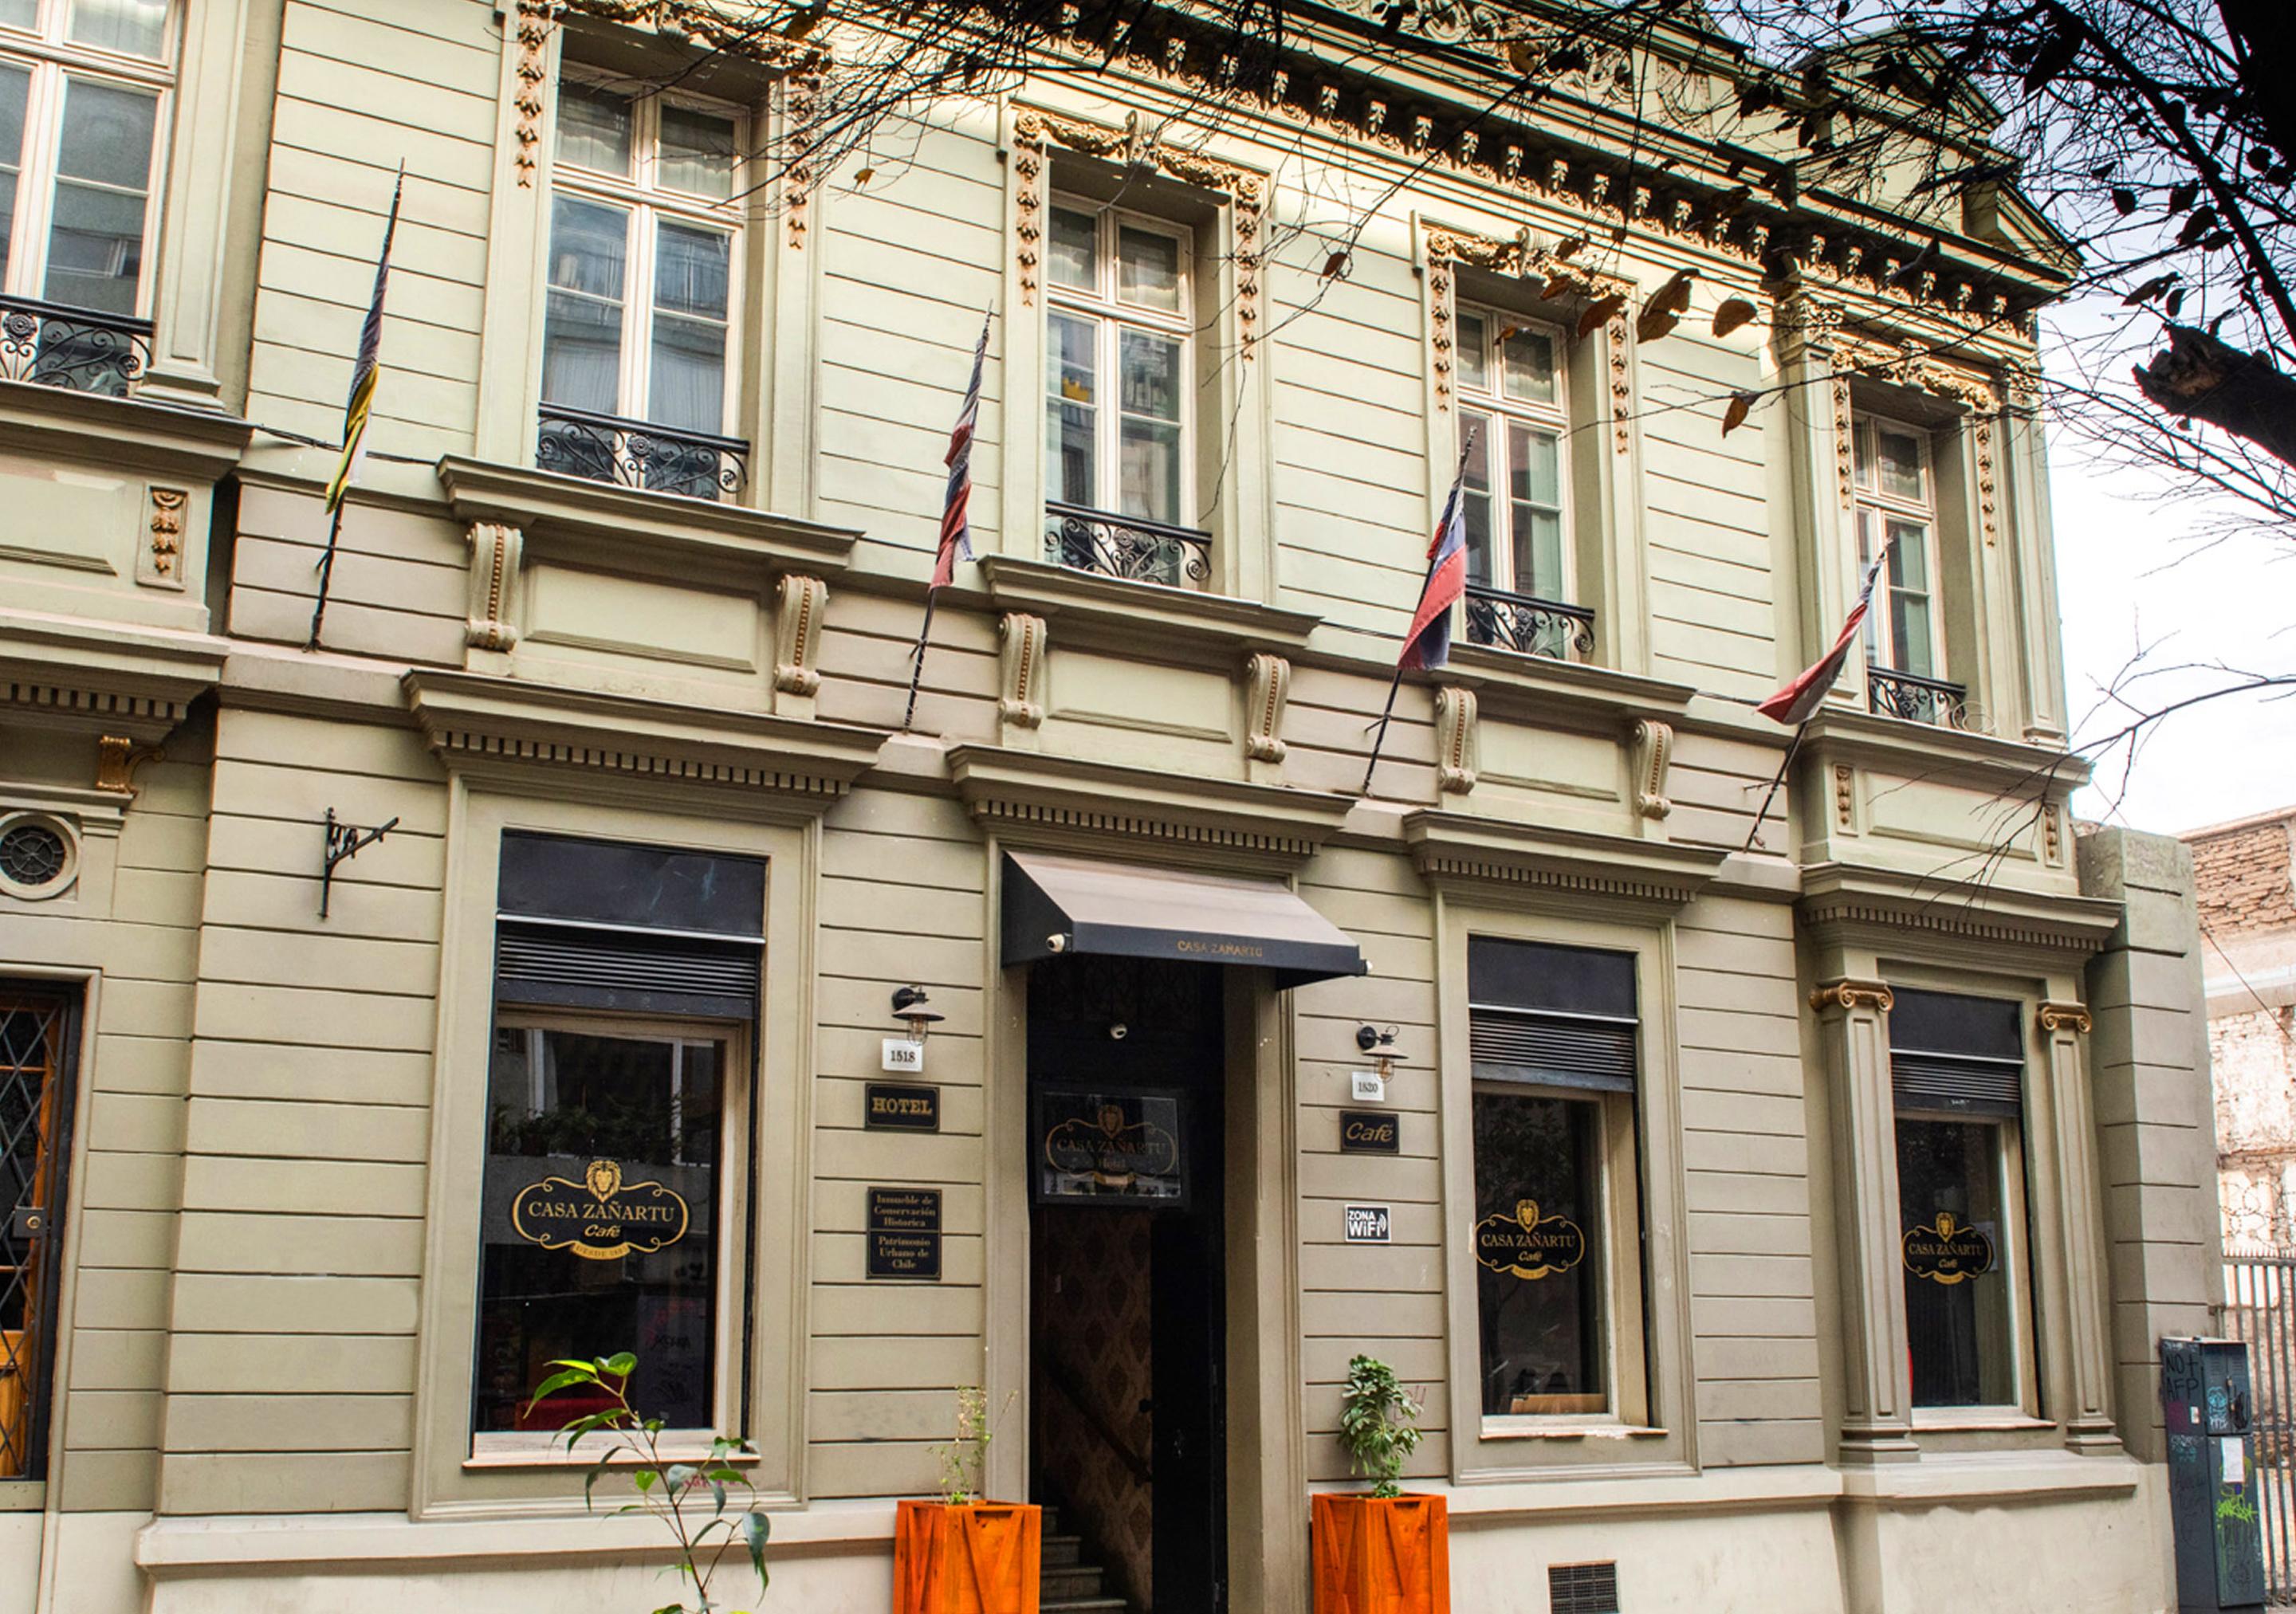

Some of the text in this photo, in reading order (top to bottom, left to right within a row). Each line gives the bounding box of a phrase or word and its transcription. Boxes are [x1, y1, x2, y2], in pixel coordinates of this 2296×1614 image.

[1177, 940, 1207, 954] CASA
[890, 1050, 916, 1063] 1518
[871, 1096, 933, 1115] HOTEL
[1346, 1122, 1394, 1143] Café
[1056, 1138, 1095, 1153] CASA
[528, 1200, 675, 1223] CASA ZAÑARTU
[1348, 1210, 1376, 1221] ZONA
[584, 1223, 621, 1238] Café
[879, 1235, 931, 1247] Patrimonio
[1480, 1231, 1576, 1248] CASA ZAÑARTU
[879, 1247, 930, 1258] Urbano de
[1909, 1241, 1984, 1256] CASA ZAÑARTU
[892, 1259, 917, 1269] Chile
